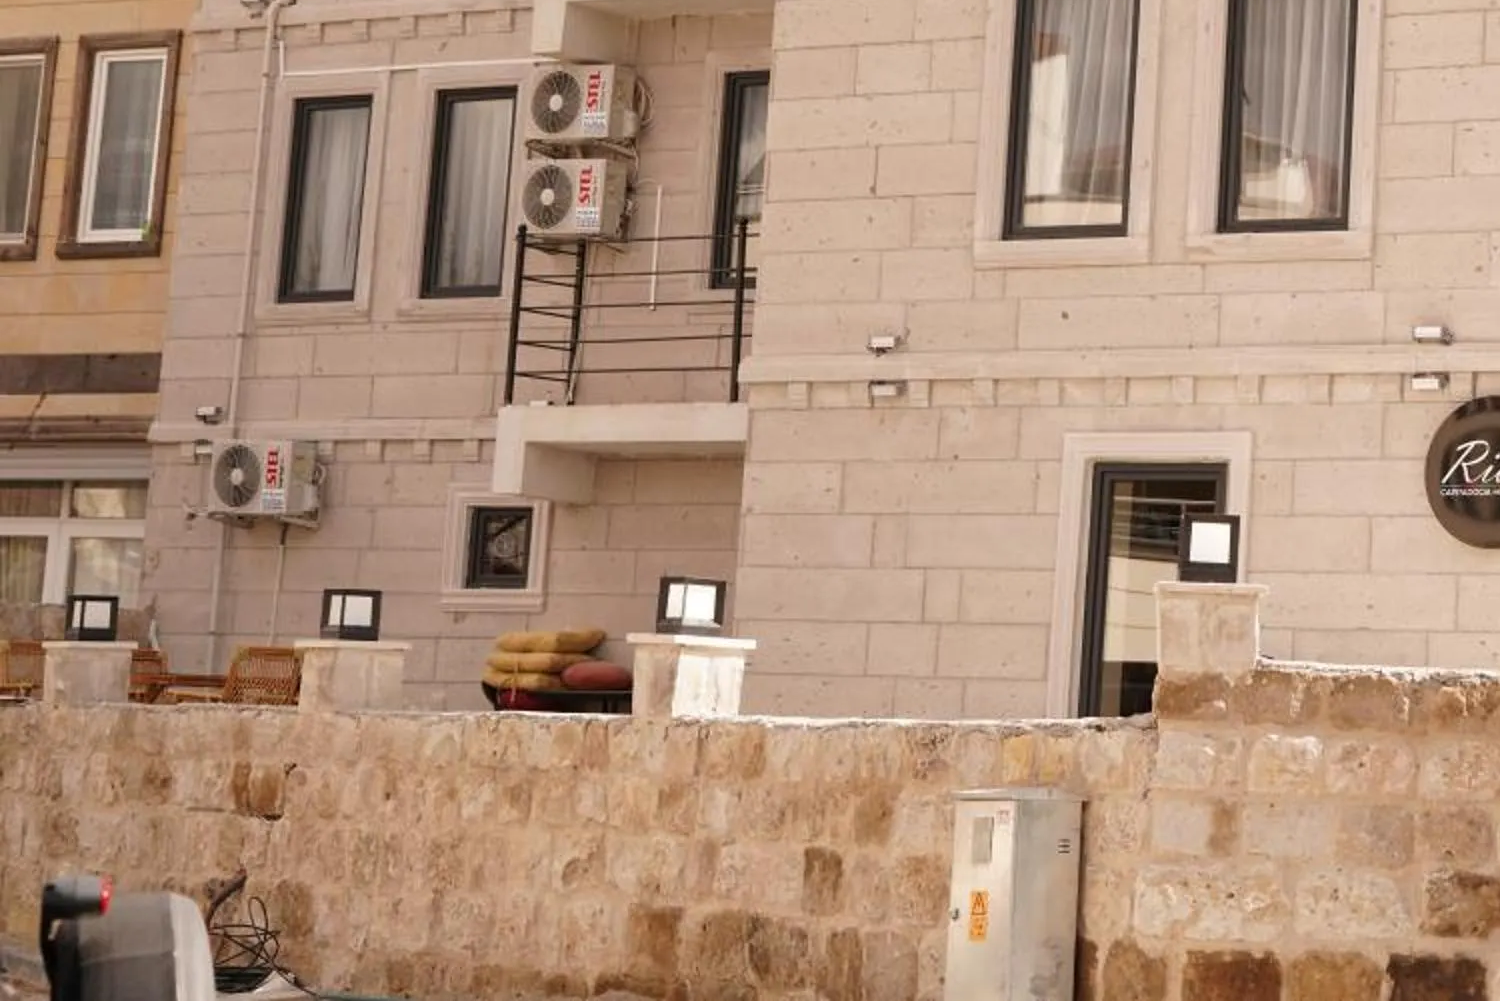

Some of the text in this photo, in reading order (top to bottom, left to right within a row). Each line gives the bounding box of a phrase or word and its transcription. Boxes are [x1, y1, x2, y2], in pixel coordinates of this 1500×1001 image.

[586, 71, 601, 113] STEL
[579, 165, 592, 204] STEL
[266, 448, 278, 486] STEL
